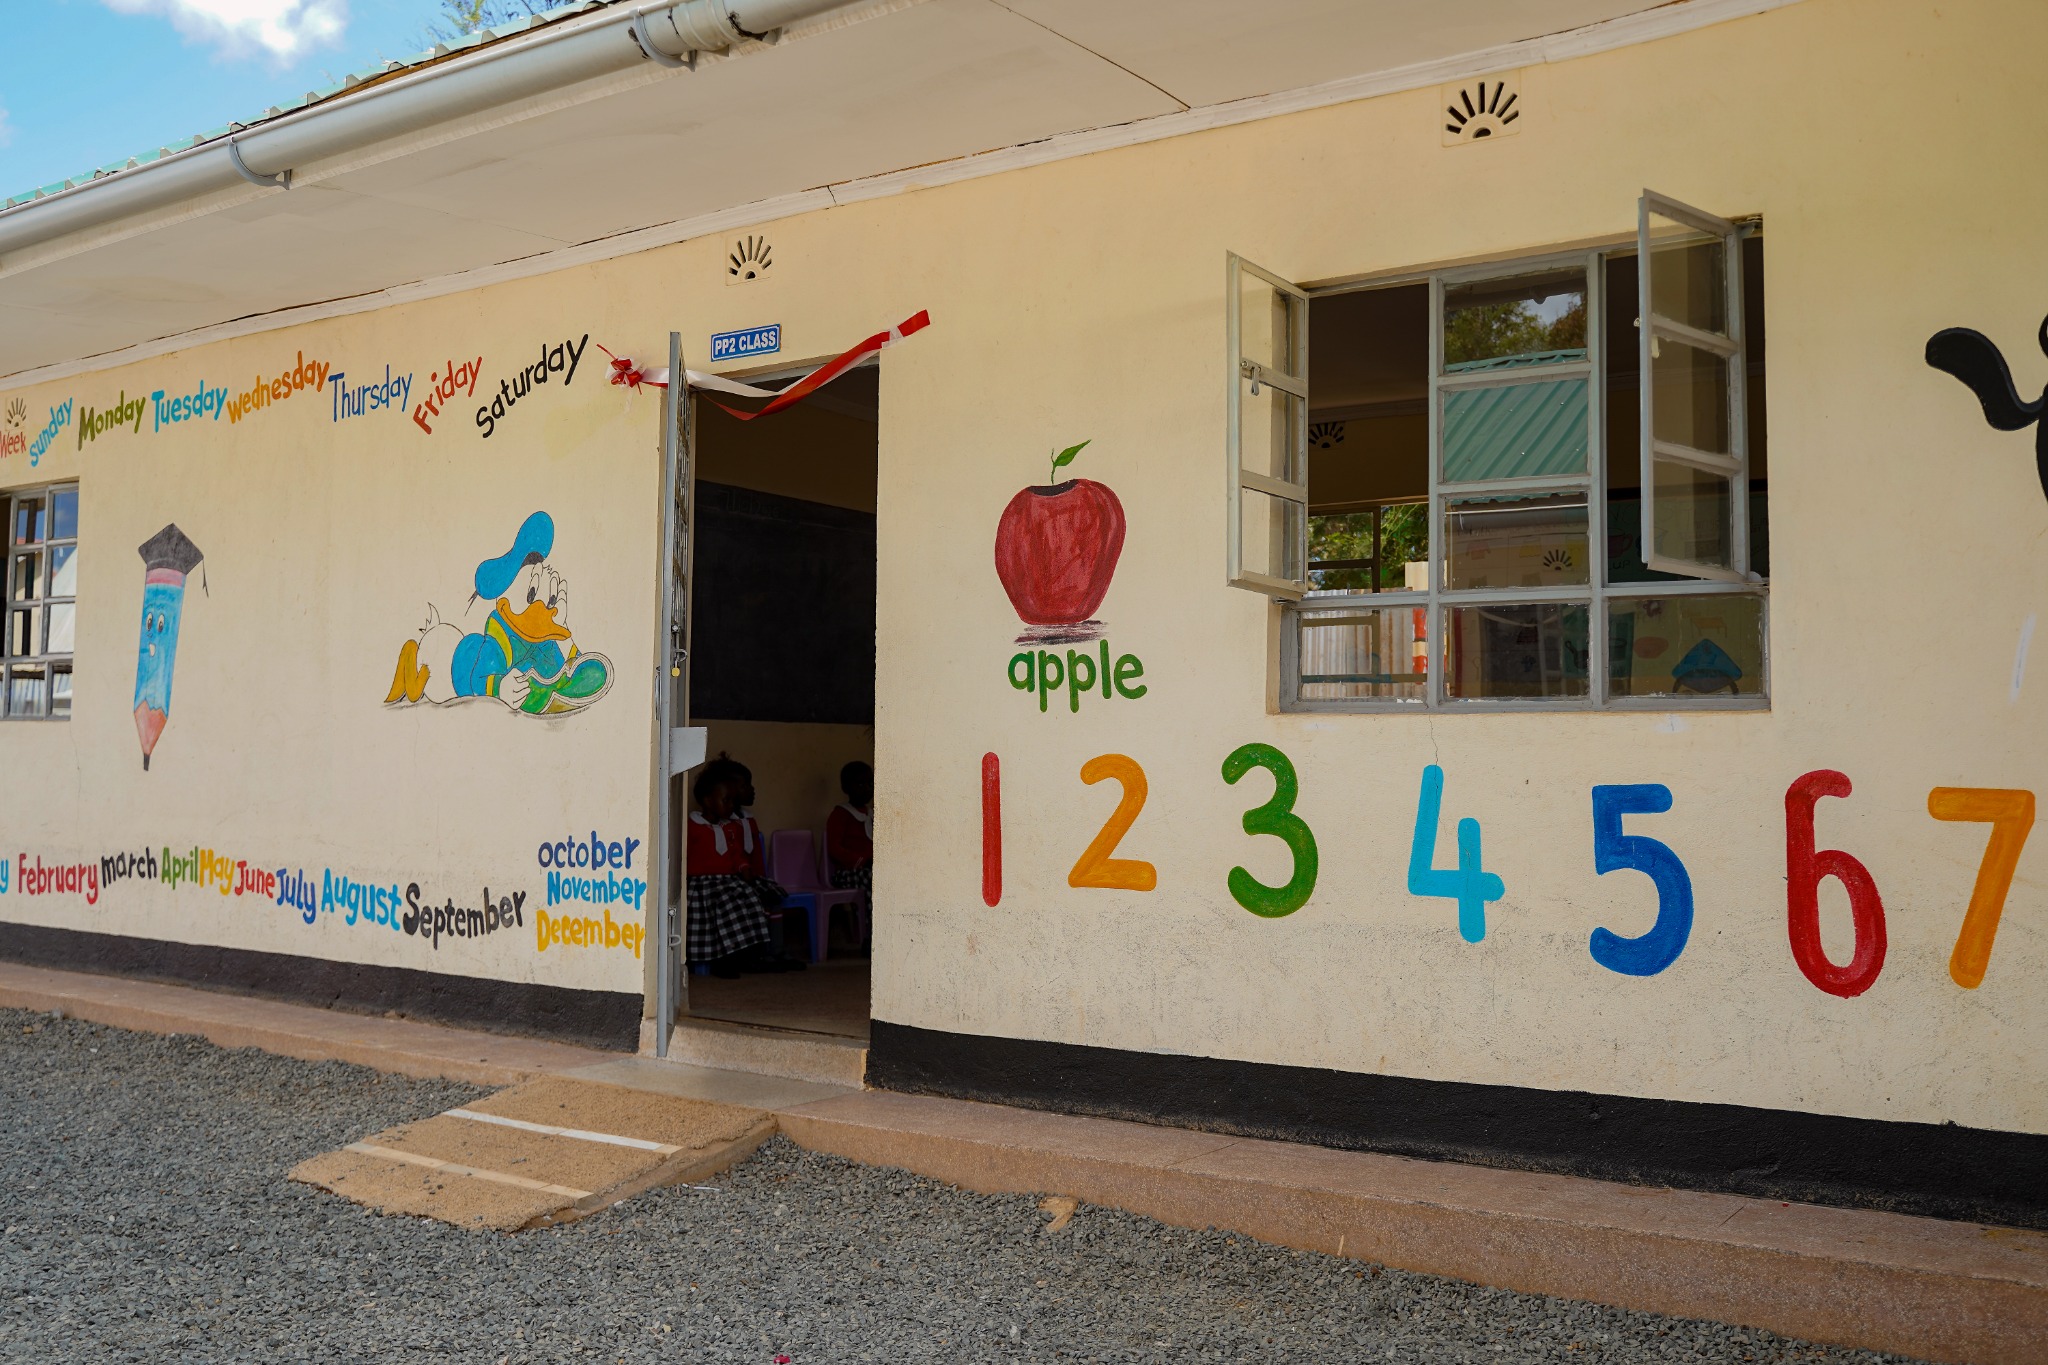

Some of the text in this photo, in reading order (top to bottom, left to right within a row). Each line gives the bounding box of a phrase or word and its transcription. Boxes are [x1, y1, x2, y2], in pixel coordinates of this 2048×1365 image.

[714, 330, 776, 356] PP2 CLASS
[78, 390, 146, 451] Monday
[151, 379, 228, 433] Tuesday
[328, 364, 412, 422] Thursday
[413, 356, 483, 435] Friday
[476, 333, 589, 438] Saturday
[0, 431, 27, 458] Week
[1008, 639, 1147, 713] apple
[18, 853, 99, 905] February
[161, 846, 199, 890] April
[199, 848, 237, 896] May
[234, 860, 276, 899] June
[276, 868, 317, 924] July
[321, 868, 402, 931] August
[402, 882, 527, 950] September
[547, 871, 647, 910] November
[981, 743, 2036, 998] 1 2 3 4 5 6 7
[536, 909, 646, 959] December
